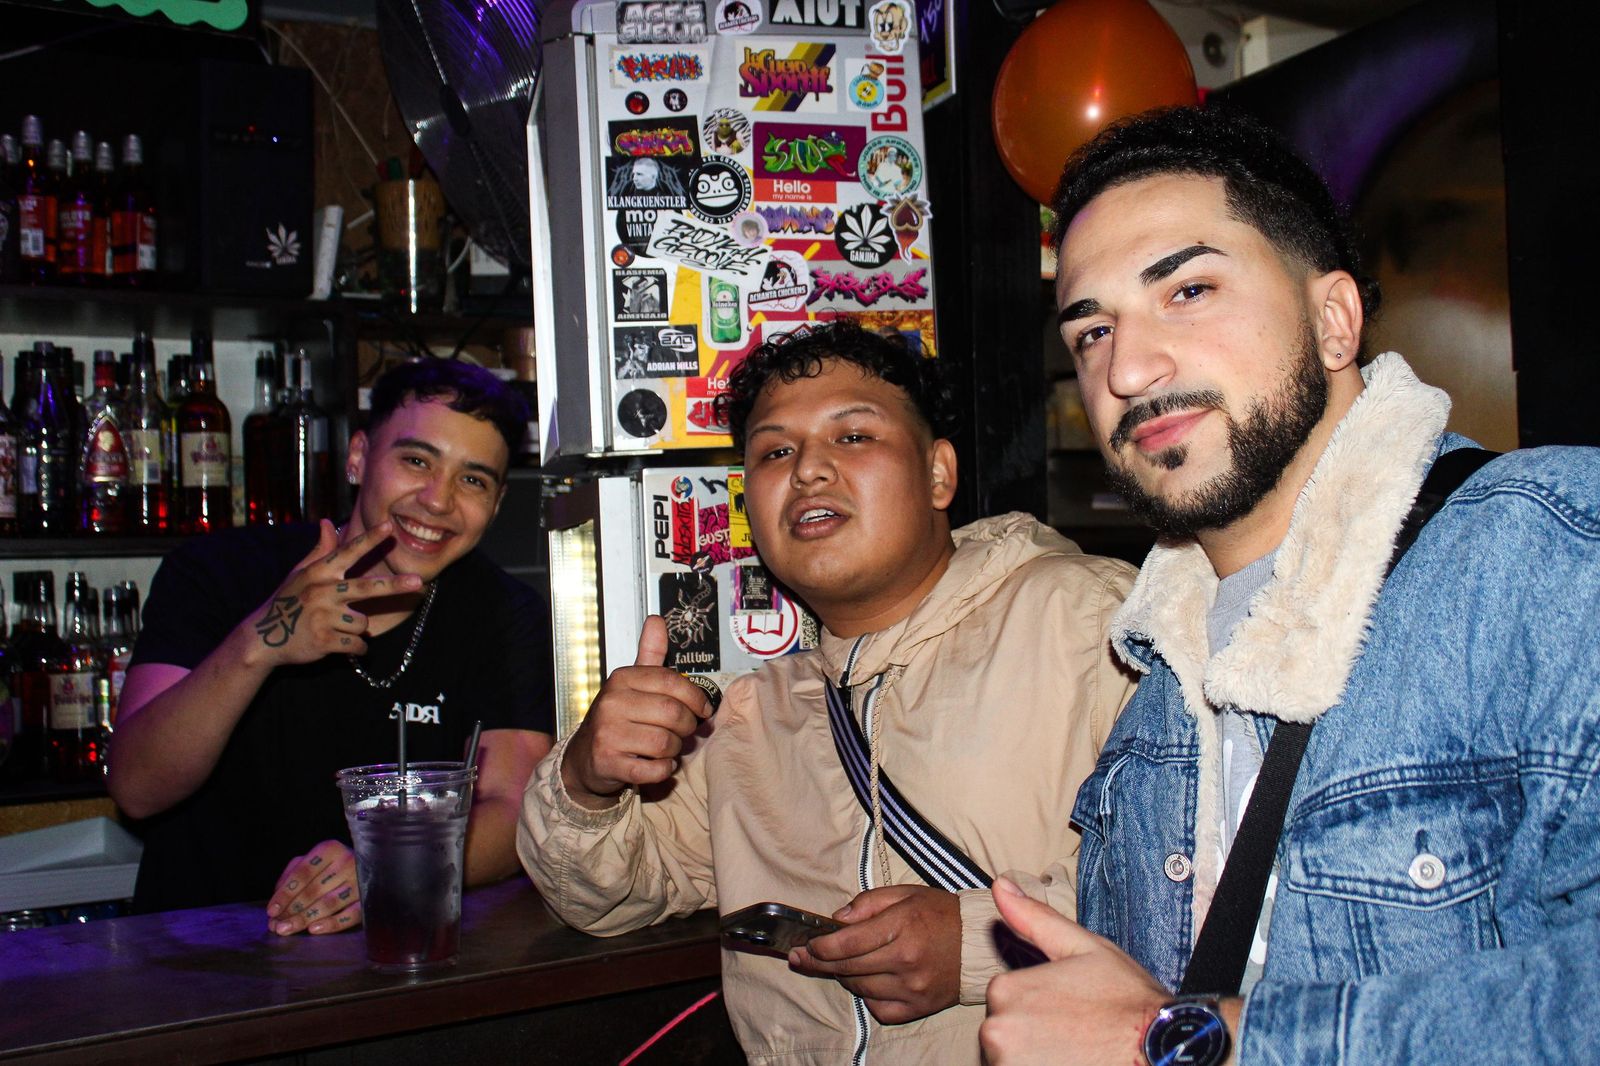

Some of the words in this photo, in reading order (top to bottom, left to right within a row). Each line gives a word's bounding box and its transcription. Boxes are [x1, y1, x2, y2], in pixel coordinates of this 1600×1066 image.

[865, 54, 908, 131] Bull
[773, 179, 811, 193] Hello
[607, 195, 687, 208] KLANGKUENSTLER
[646, 361, 676, 372] ADRIAN
[653, 494, 671, 559] PEPI
